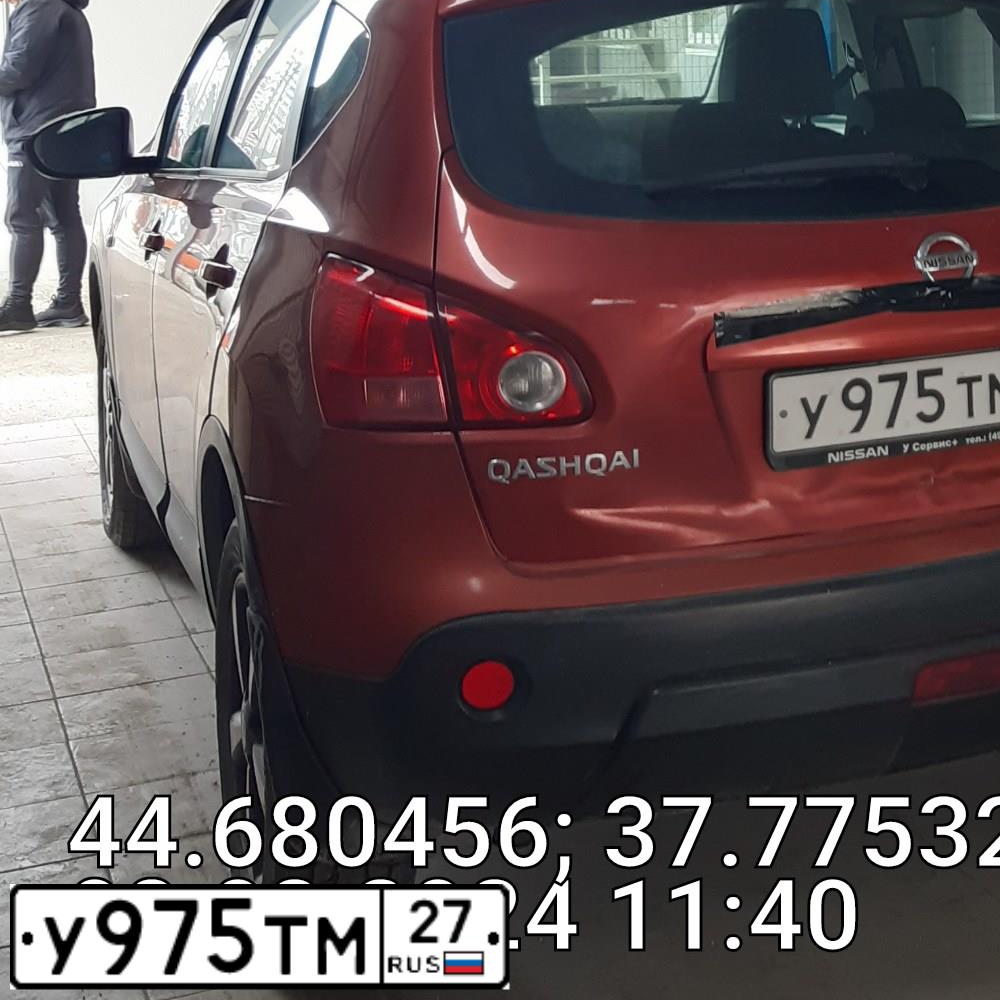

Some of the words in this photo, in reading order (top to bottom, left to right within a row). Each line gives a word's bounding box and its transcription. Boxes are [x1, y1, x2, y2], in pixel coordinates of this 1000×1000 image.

[923, 253, 974, 268] NISSAN
[827, 445, 889, 464] NISSAN
[487, 448, 640, 485] QASHQAI
